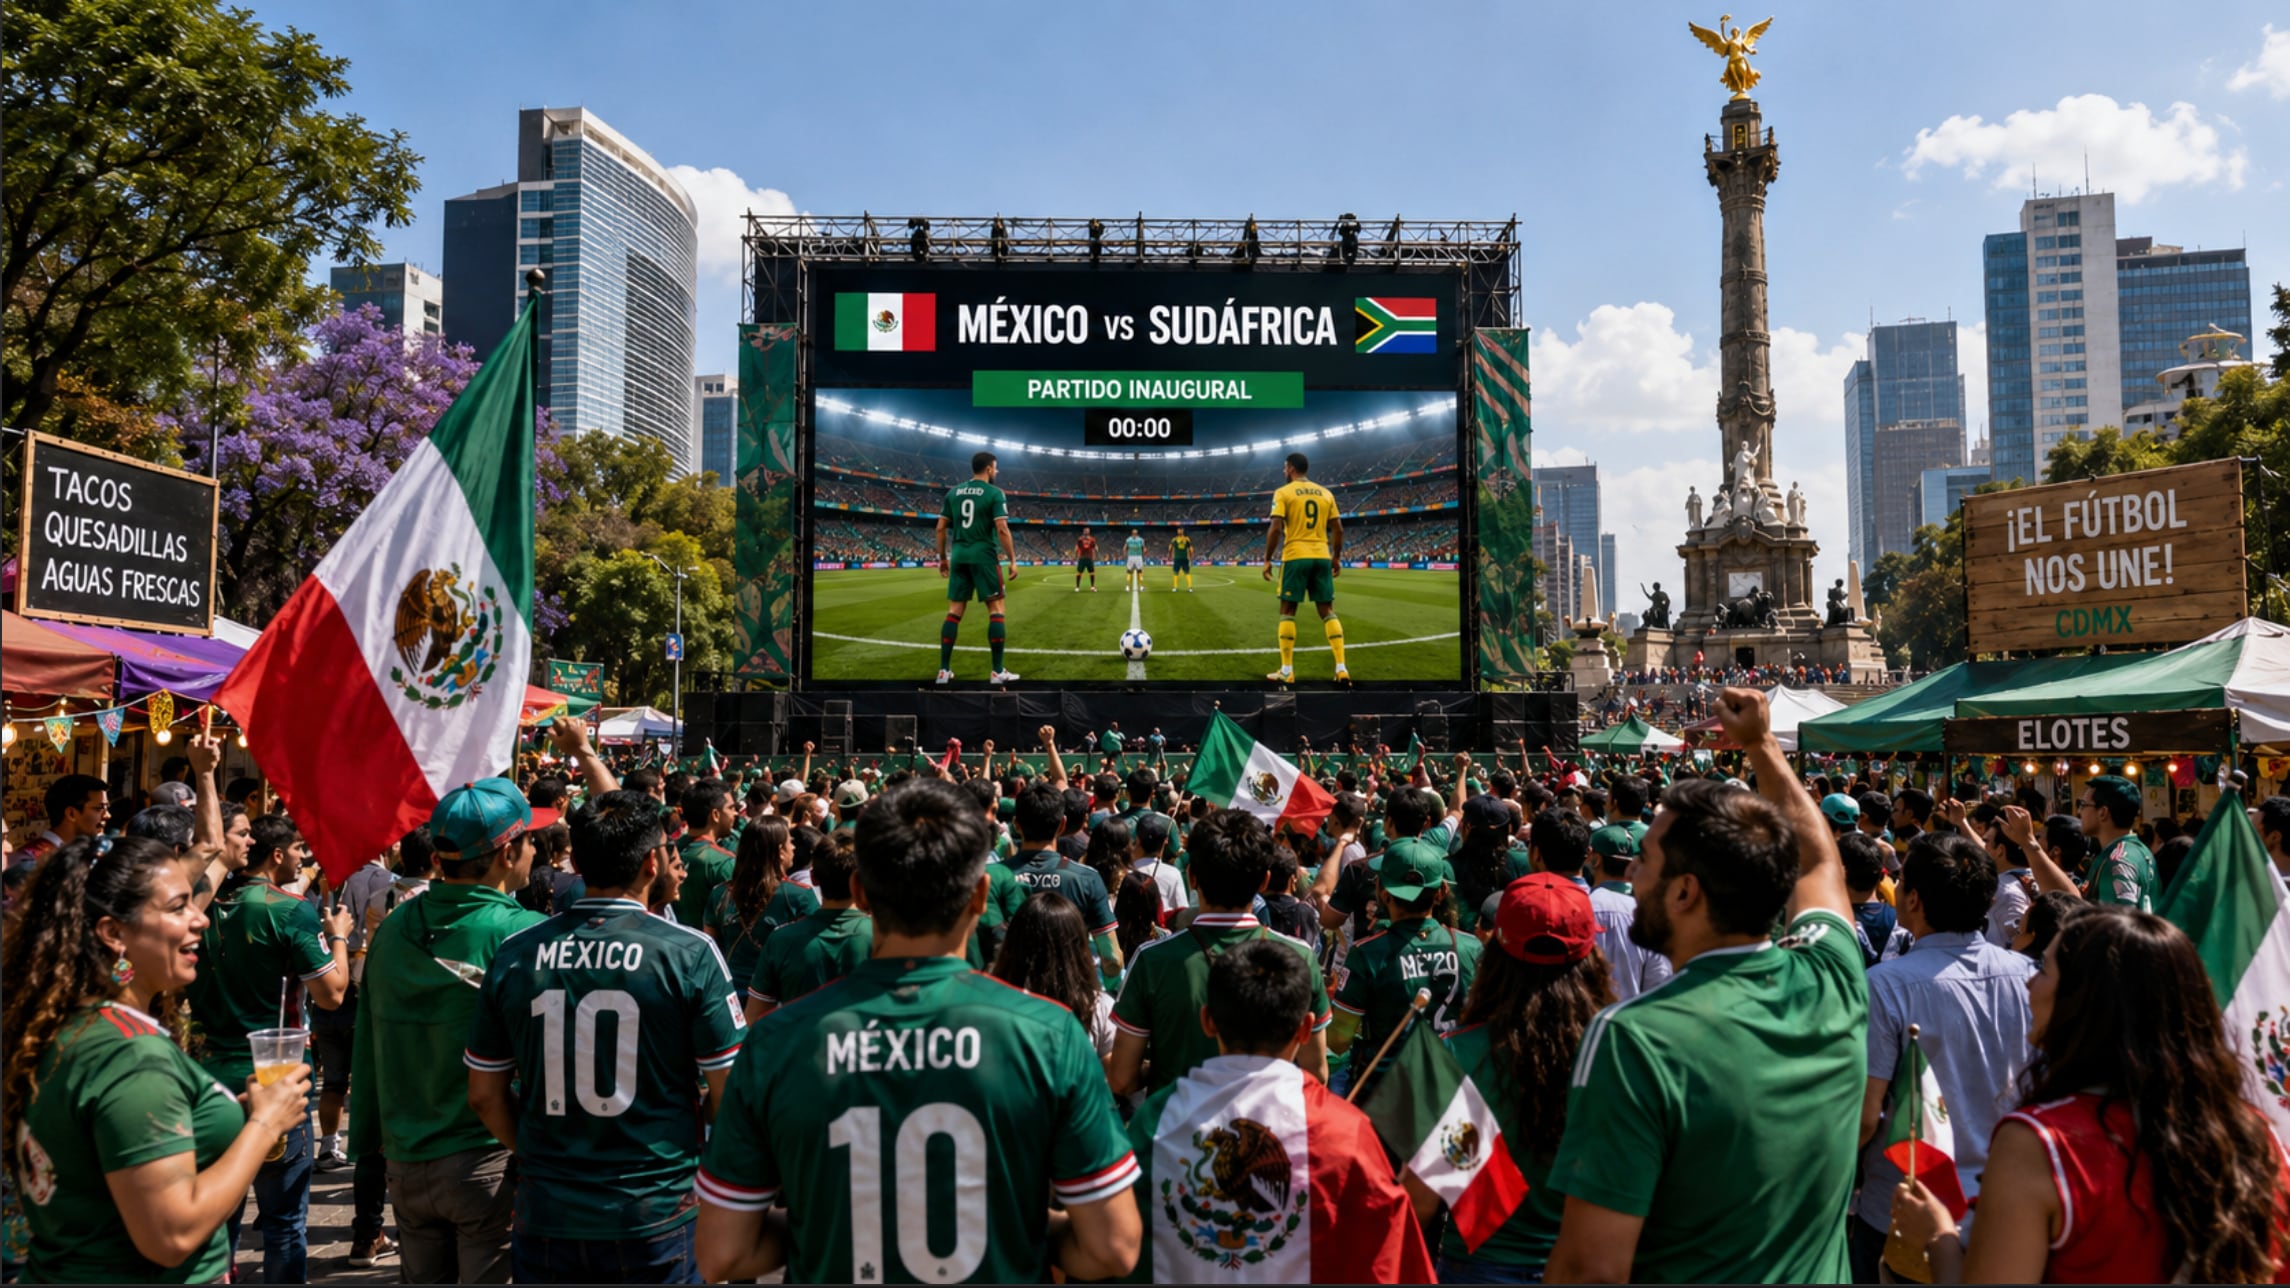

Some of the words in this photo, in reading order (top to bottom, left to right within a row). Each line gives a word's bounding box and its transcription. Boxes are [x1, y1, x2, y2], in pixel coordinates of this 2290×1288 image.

[958, 297, 1089, 344] MÉXICO
[1149, 297, 1337, 345] SUDÁFRICA
[1028, 379, 1122, 399] PARTIDO
[1129, 379, 1252, 400] INAUGURAL
[1108, 417, 1171, 438] 00:00
[48, 466, 132, 512] TACOS
[44, 510, 187, 563] QUESADILLAS
[961, 498, 975, 529] 9
[1305, 499, 1318, 530] 9
[2007, 505, 2052, 553] ¡EL
[2064, 489, 2187, 539] FÚTBOL
[41, 557, 113, 596] AGUAS
[121, 569, 200, 608] FRESCAS
[2025, 553, 2086, 596] NOS
[2097, 543, 2174, 589] UNE!
[2056, 604, 2133, 638] CDMX
[2018, 717, 2131, 750] ELOTES
[535, 937, 643, 972] MÉXICO
[531, 989, 640, 1116] 10
[826, 1020, 982, 1074] MÉXICO
[829, 1102, 988, 1284] 10
